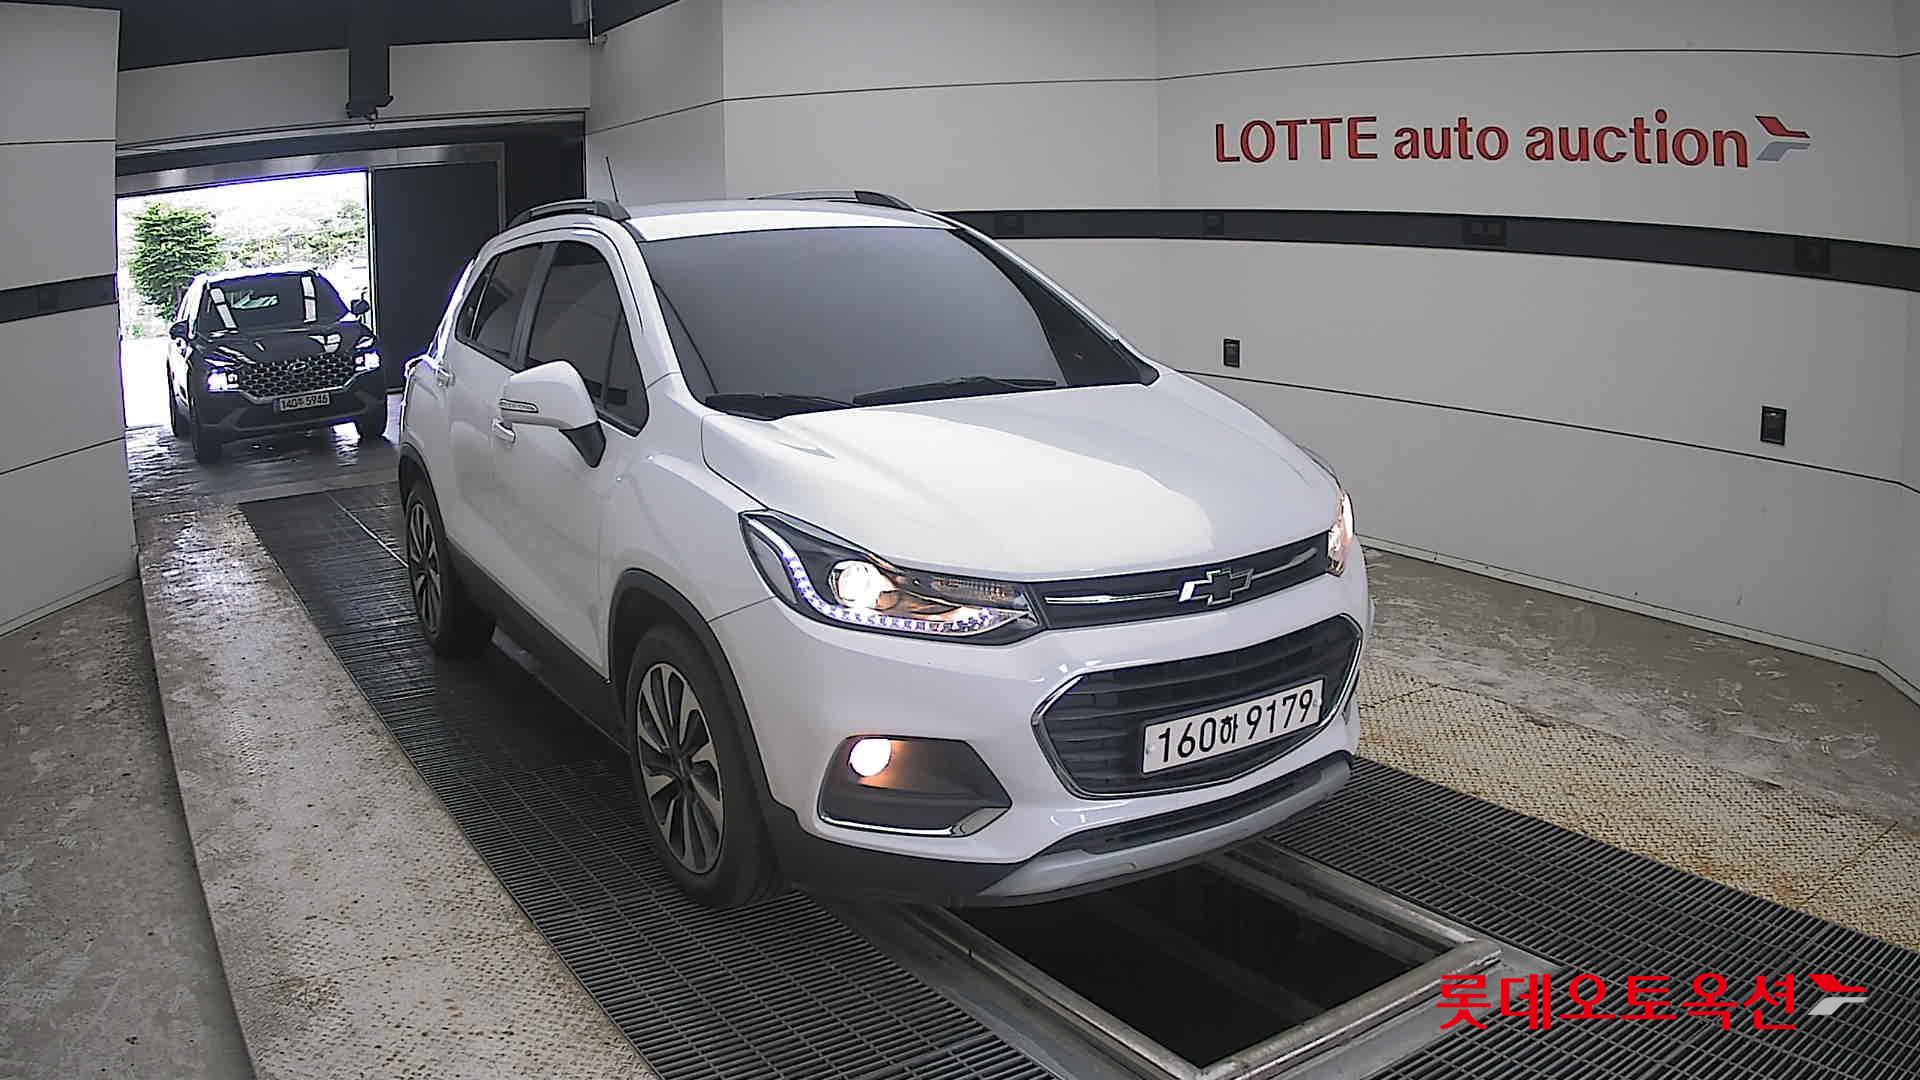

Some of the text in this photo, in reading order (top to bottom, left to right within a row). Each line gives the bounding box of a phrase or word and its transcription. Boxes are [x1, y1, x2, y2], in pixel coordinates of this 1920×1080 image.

[1214, 108, 1749, 169] LOTTE auto auction
[1157, 688, 1314, 763] 160하 9179
